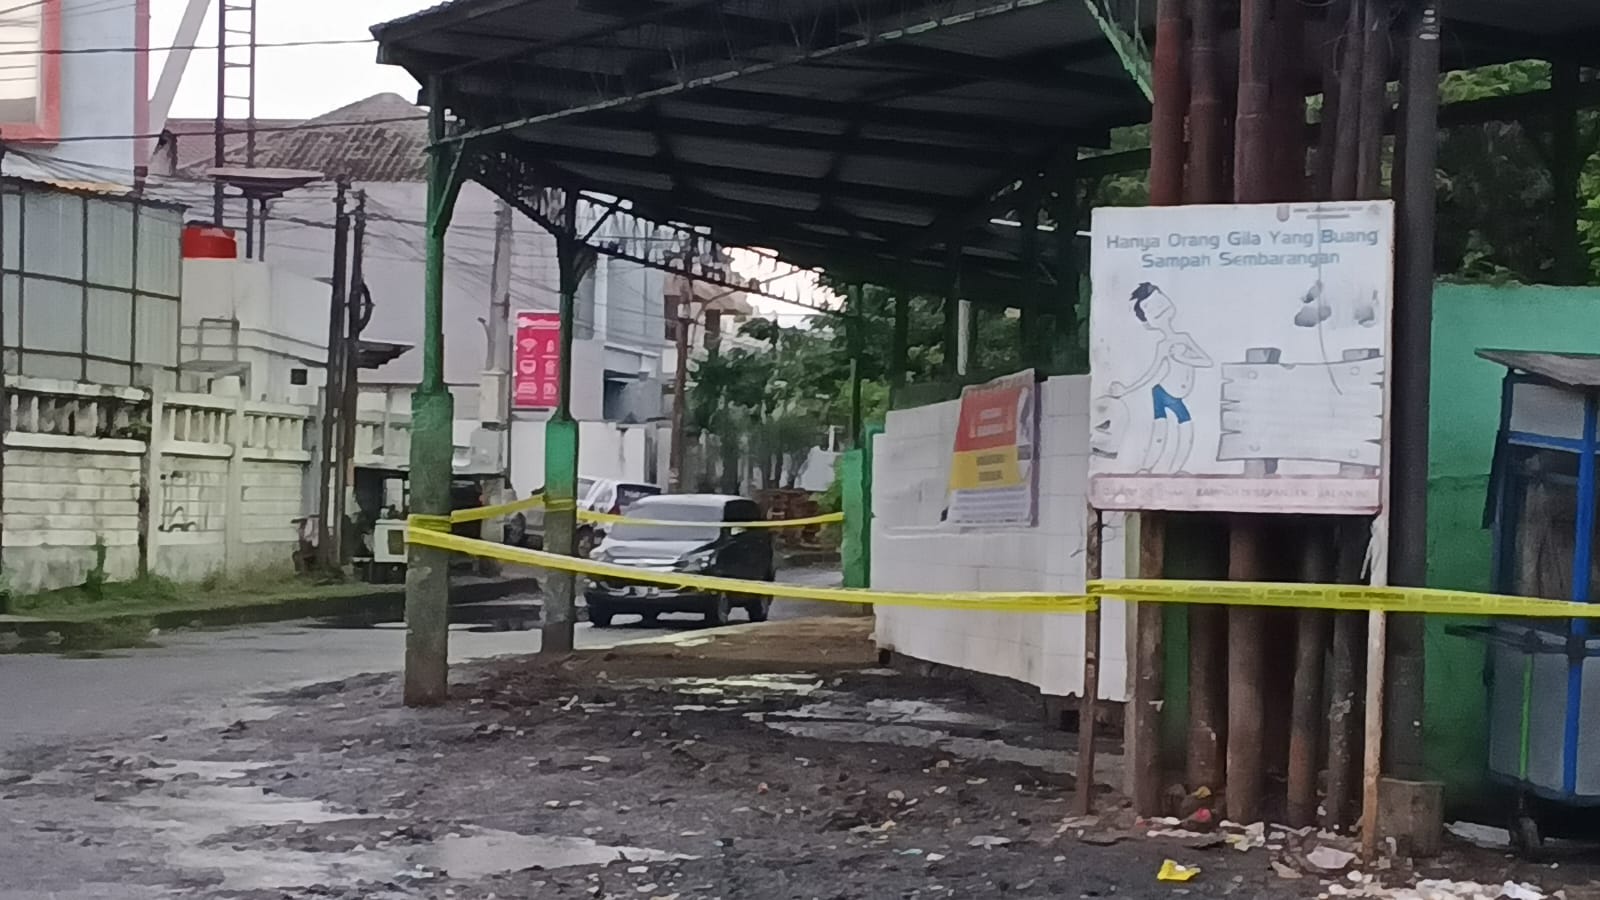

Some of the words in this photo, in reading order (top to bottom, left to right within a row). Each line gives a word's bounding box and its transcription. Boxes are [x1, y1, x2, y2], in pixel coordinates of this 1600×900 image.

[1106, 235, 1160, 251] Hanya
[1168, 233, 1220, 249] Orang
[1227, 231, 1261, 246] Gila
[1269, 230, 1313, 248] Yang
[1320, 229, 1378, 246] Buang
[1219, 251, 1340, 268] Sembarangan
